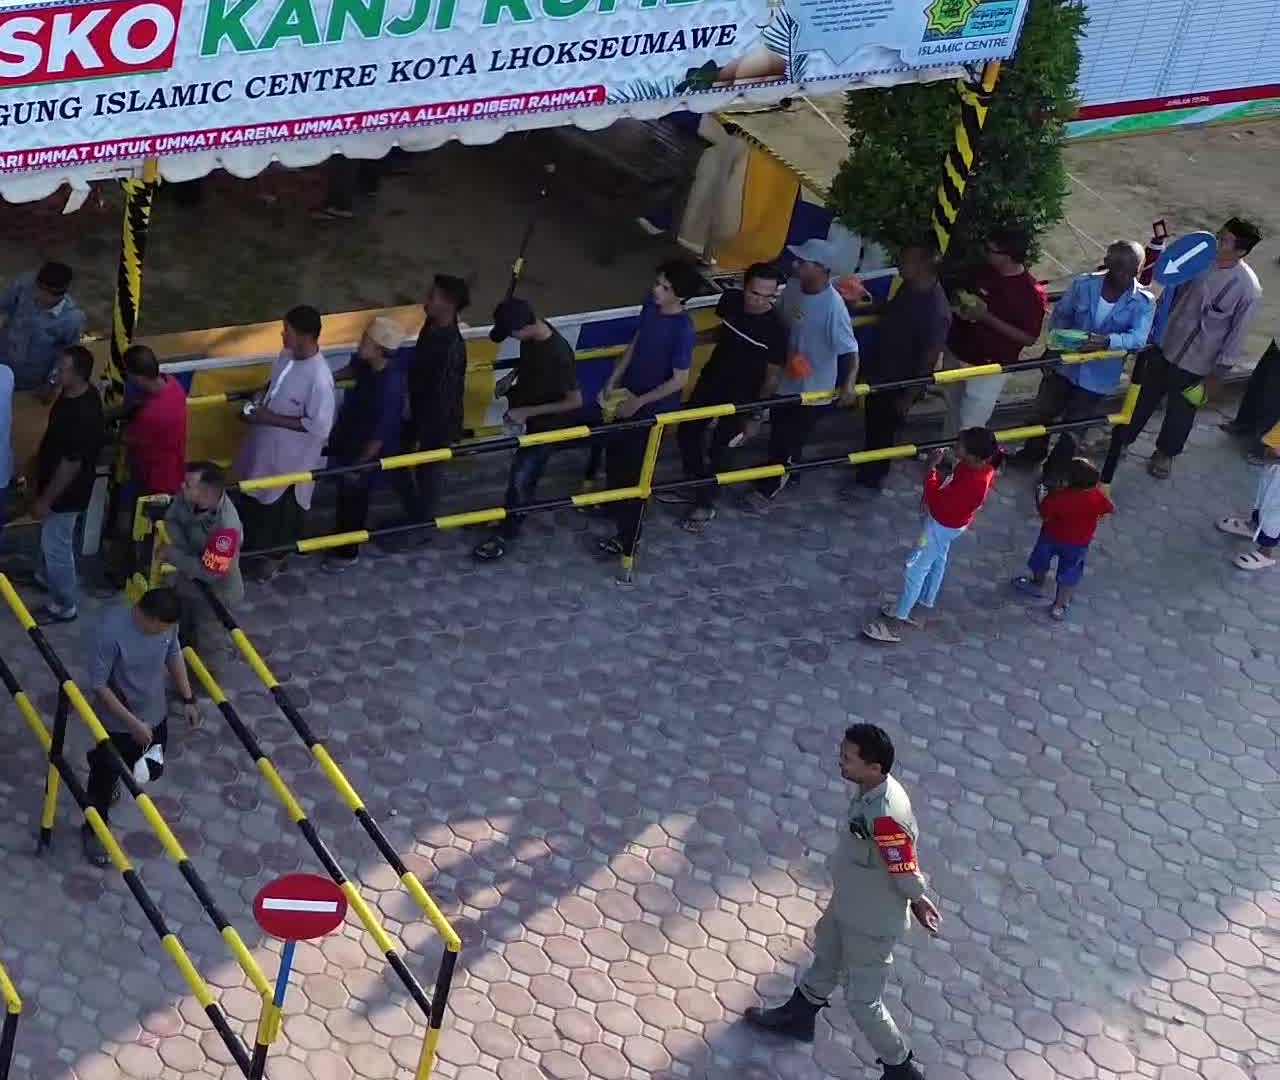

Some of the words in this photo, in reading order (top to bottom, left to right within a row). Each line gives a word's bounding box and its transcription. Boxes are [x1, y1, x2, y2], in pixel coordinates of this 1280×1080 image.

[94, 79, 233, 116] ISLAMIC
[245, 64, 377, 100] CENTRE
[387, 54, 476, 83] KOTA
[488, 24, 738, 72] LHOKSEUMAWE
[919, 42, 963, 56] ISLAMIC
[965, 37, 1009, 51] CENTRE
[27, 147, 90, 167] UMMAT
[93, 140, 152, 159] UNTUK
[155, 132, 217, 152] UMMAT
[220, 125, 289, 143] KARENA
[294, 117, 356, 136] UMMAT,
[361, 111, 410, 127] INSYA
[415, 103, 468, 121] ALLAH
[472, 98, 524, 115] DIBERI
[527, 88, 597, 108] RAHMAT
